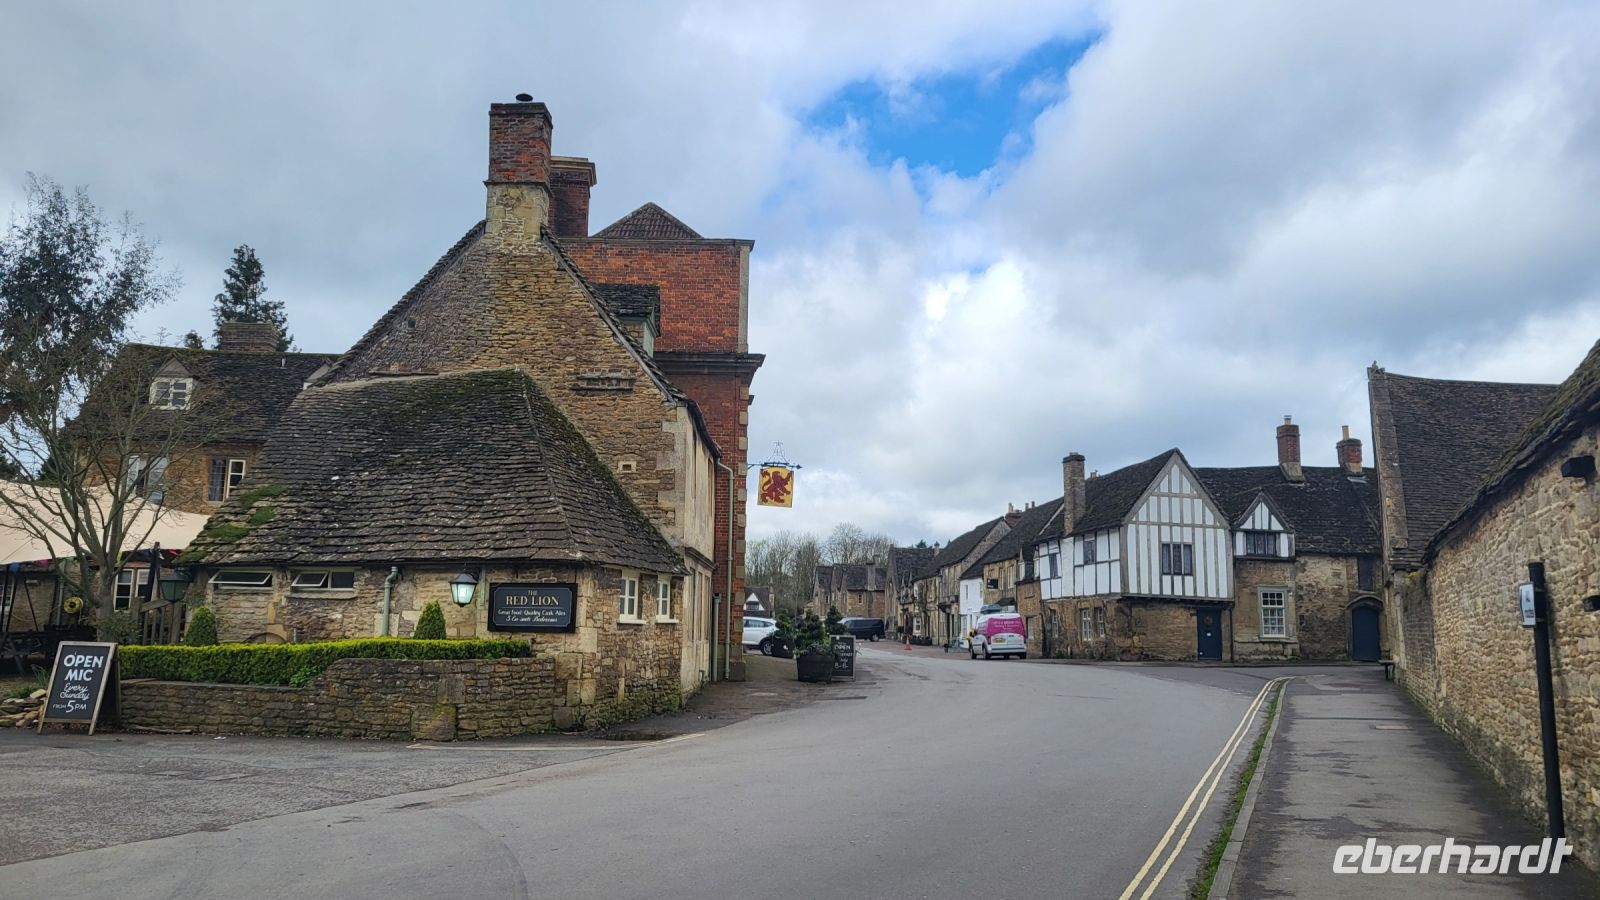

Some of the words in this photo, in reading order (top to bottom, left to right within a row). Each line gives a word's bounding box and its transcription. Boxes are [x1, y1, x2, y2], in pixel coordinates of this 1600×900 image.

[505, 596, 528, 606] RED
[531, 596, 559, 606] LION
[63, 654, 104, 668] OPEN
[64, 669, 94, 681] MIC
[63, 682, 89, 694] Every
[59, 690, 90, 701] Sunday
